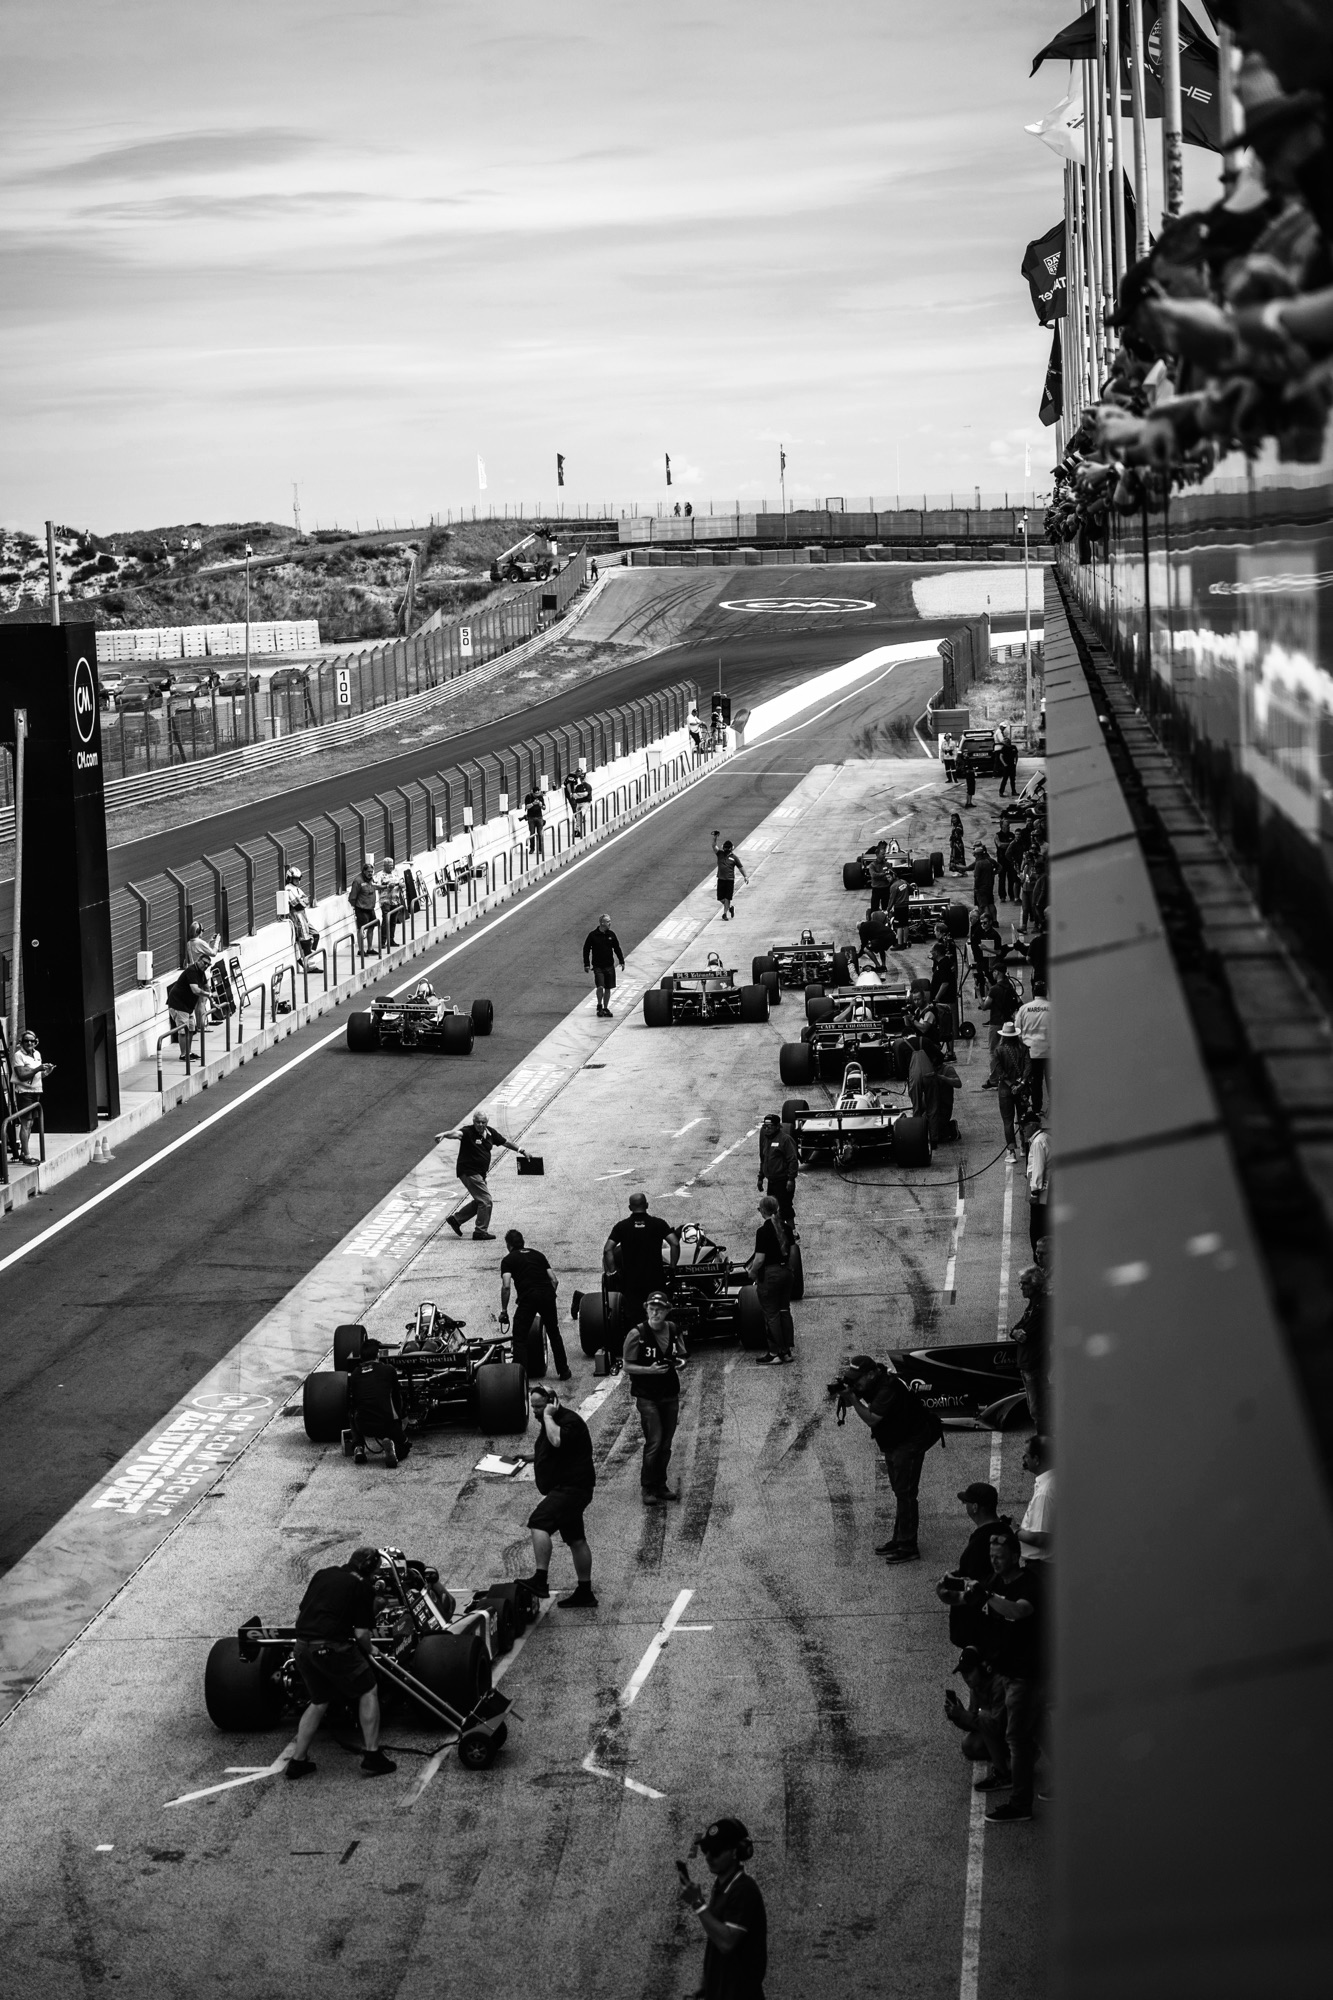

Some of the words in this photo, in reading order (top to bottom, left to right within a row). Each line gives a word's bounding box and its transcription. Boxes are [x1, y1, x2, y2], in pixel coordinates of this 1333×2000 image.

[462, 628, 470, 646] 50
[339, 671, 348, 703] 100
[76, 751, 99, 769] CM.com
[378, 1003, 432, 1011] Marlboro
[685, 1264, 720, 1273] Special
[419, 1354, 457, 1364] Special
[645, 1346, 657, 1358] 31
[195, 1414, 256, 1462] CM.COM
[91, 1410, 228, 1514] ZANDVOORT
[147, 1464, 210, 1517] CIRCUIT
[246, 1628, 280, 1640] elf
